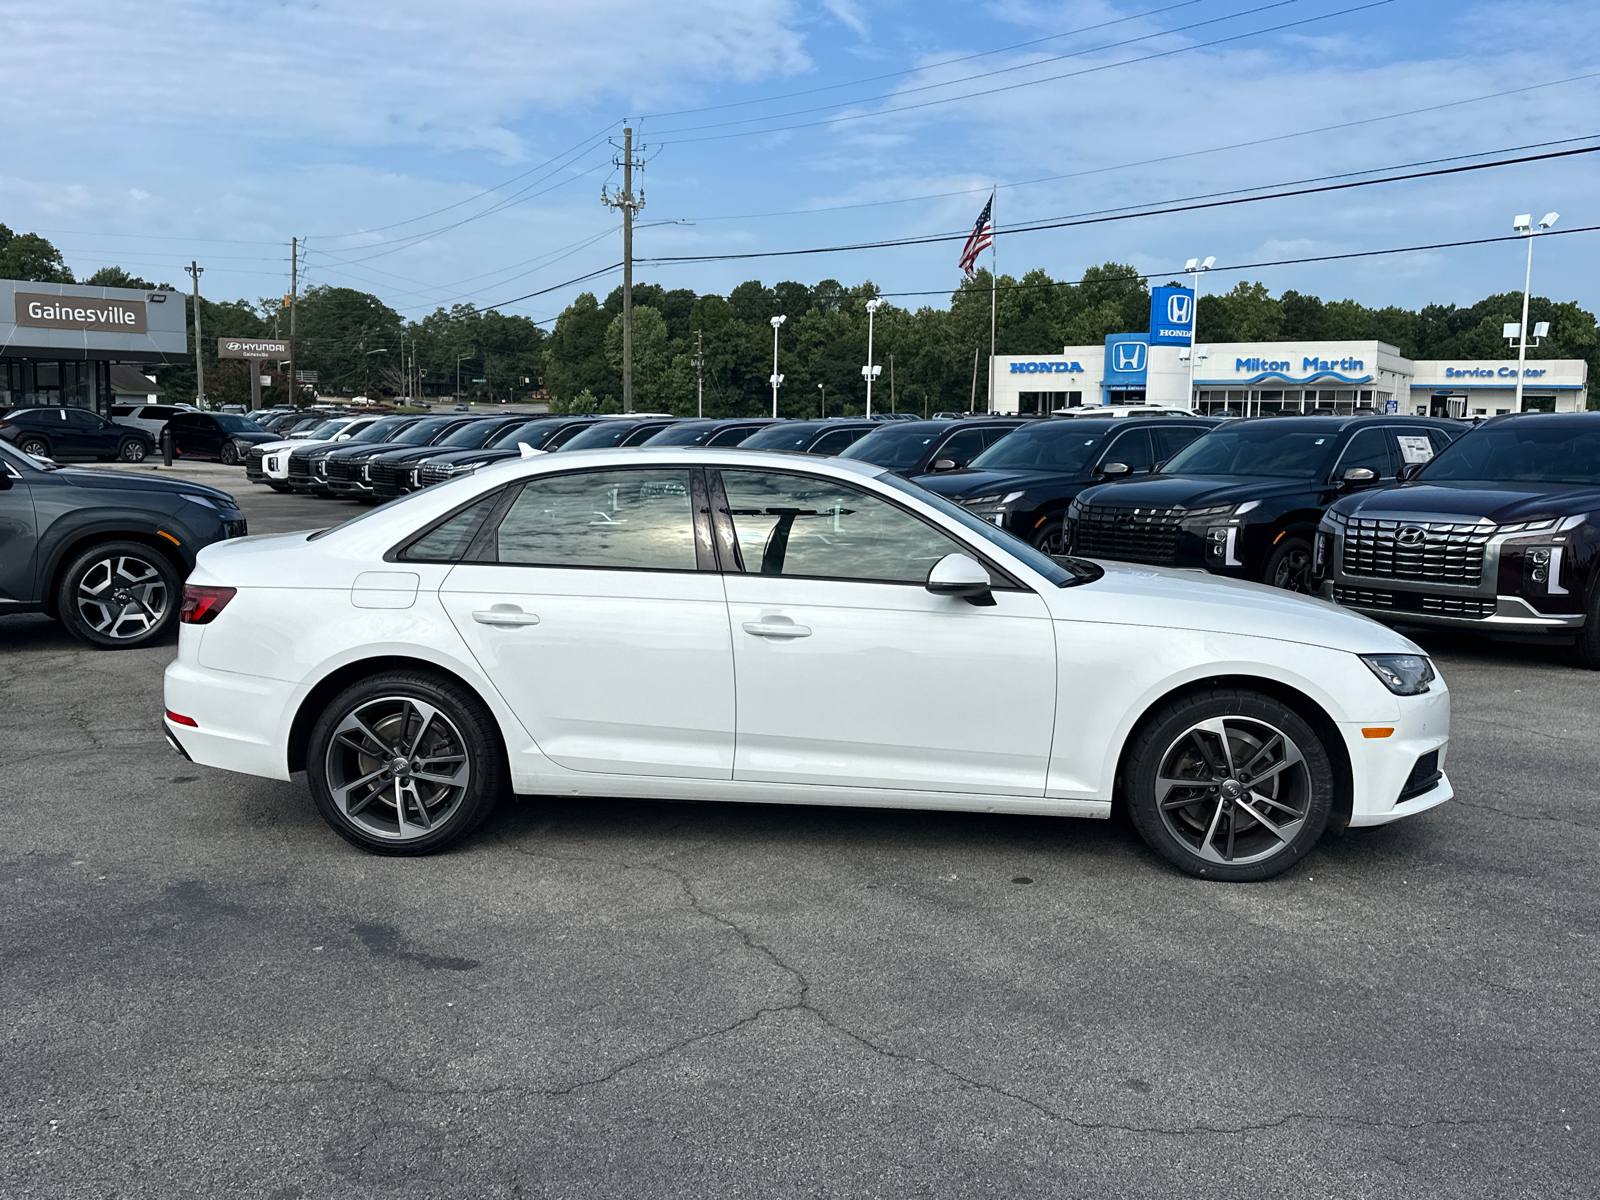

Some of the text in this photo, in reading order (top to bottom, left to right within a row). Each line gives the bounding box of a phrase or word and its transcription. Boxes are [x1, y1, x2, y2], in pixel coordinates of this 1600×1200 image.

[28, 302, 135, 324] Gainesville
[242, 343, 285, 352] HYUNDAI
[1010, 362, 1084, 373] HONDA
[1235, 356, 1364, 371] Milton Martin
[1446, 367, 1546, 377] Service Ceter
